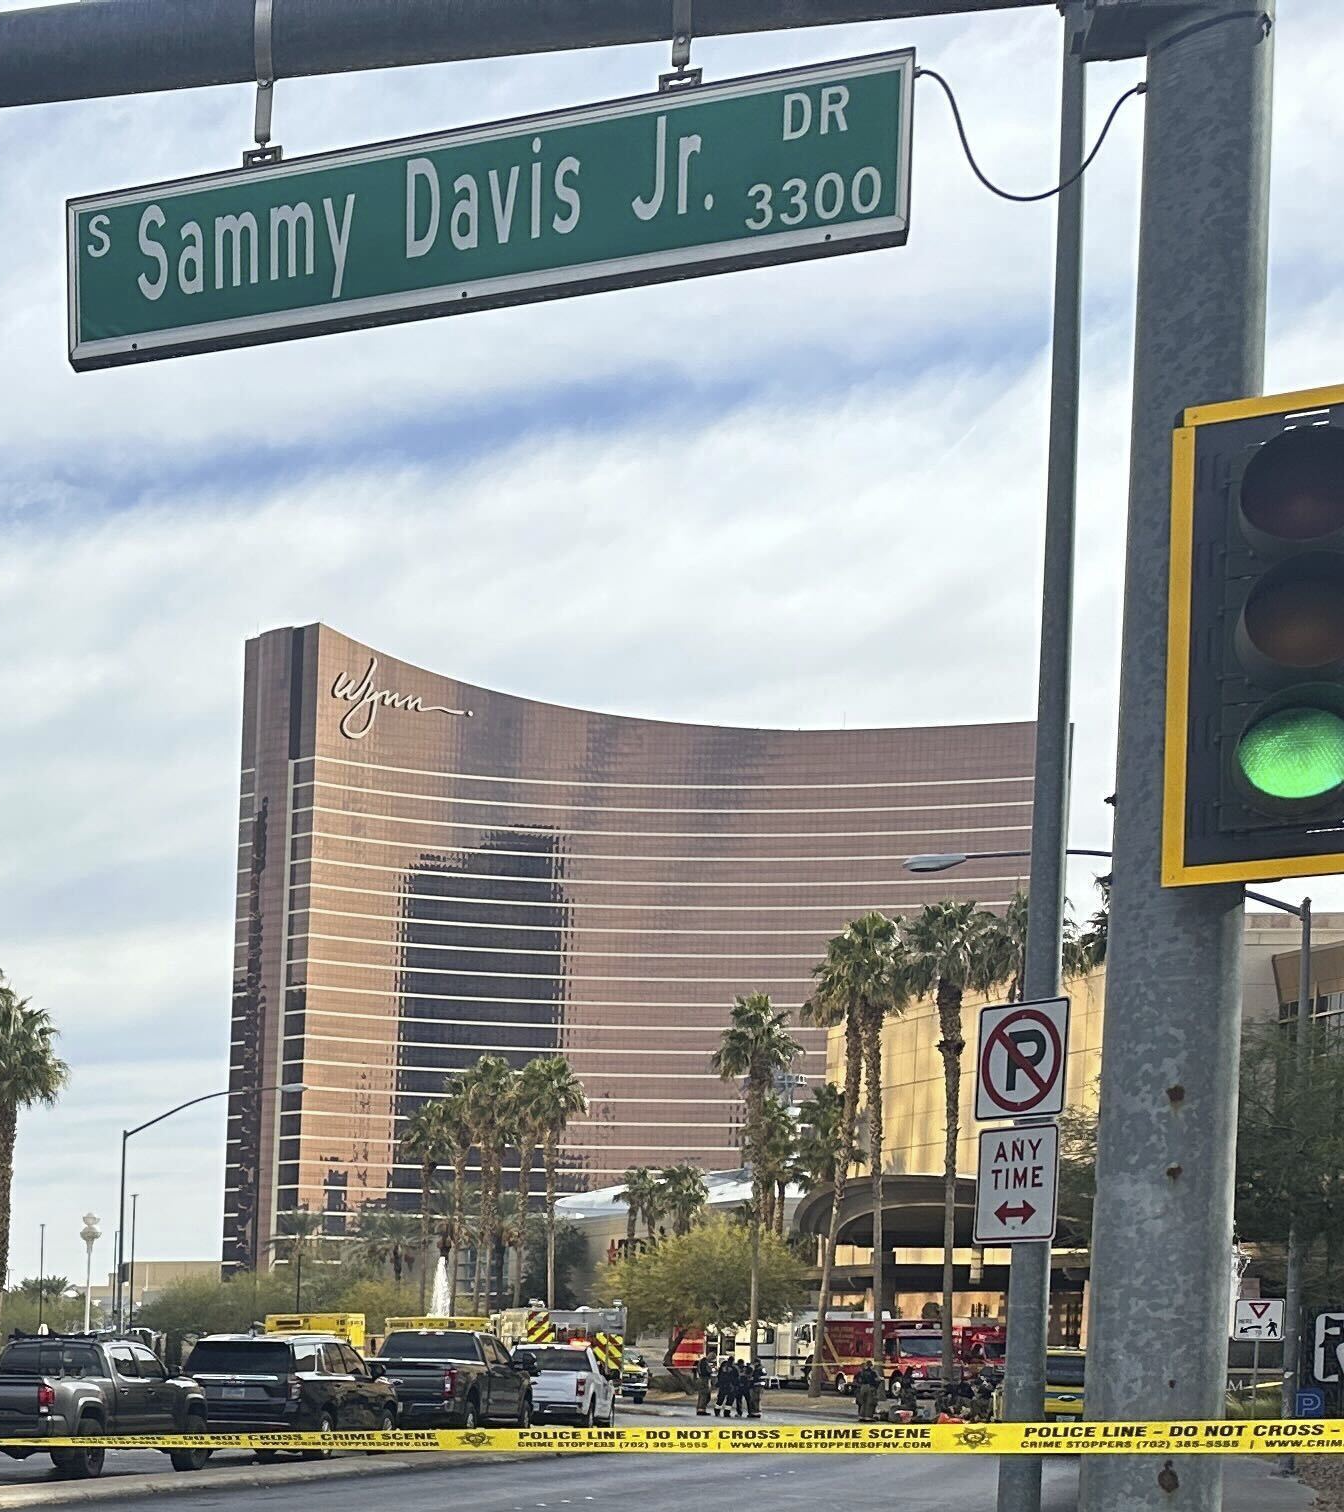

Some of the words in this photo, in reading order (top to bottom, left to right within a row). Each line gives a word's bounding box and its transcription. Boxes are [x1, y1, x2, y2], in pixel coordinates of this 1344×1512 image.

[783, 85, 851, 142] DR
[87, 214, 112, 258] S
[137, 193, 357, 301] Sammy
[405, 136, 582, 260] Davis
[631, 115, 714, 222] Jr.
[744, 165, 883, 231] 3300
[993, 1137, 1043, 1164] ANY
[991, 1165, 1044, 1191] TIME
[247, 1433, 303, 1441] CROSS
[320, 1433, 375, 1441] CRIME
[381, 1432, 437, 1440] SCENE
[518, 1431, 582, 1440] POLICE
[587, 1430, 627, 1440] LINE
[645, 1430, 671, 1440] DO
[676, 1430, 712, 1440] NOT
[718, 1430, 781, 1440] CROSS
[800, 1429, 863, 1439] CRIME
[868, 1428, 931, 1439] SCENE
[1024, 1426, 1096, 1438] POLICE
[1102, 1426, 1148, 1437] LINE
[1169, 1425, 1199, 1437] DO
[1204, 1425, 1247, 1437] NOT
[1253, 1424, 1325, 1436] CROSS
[1020, 1440, 1062, 1448] CRIME
[1066, 1440, 1132, 1448] STOPPERS
[1136, 1440, 1170, 1449] (702)
